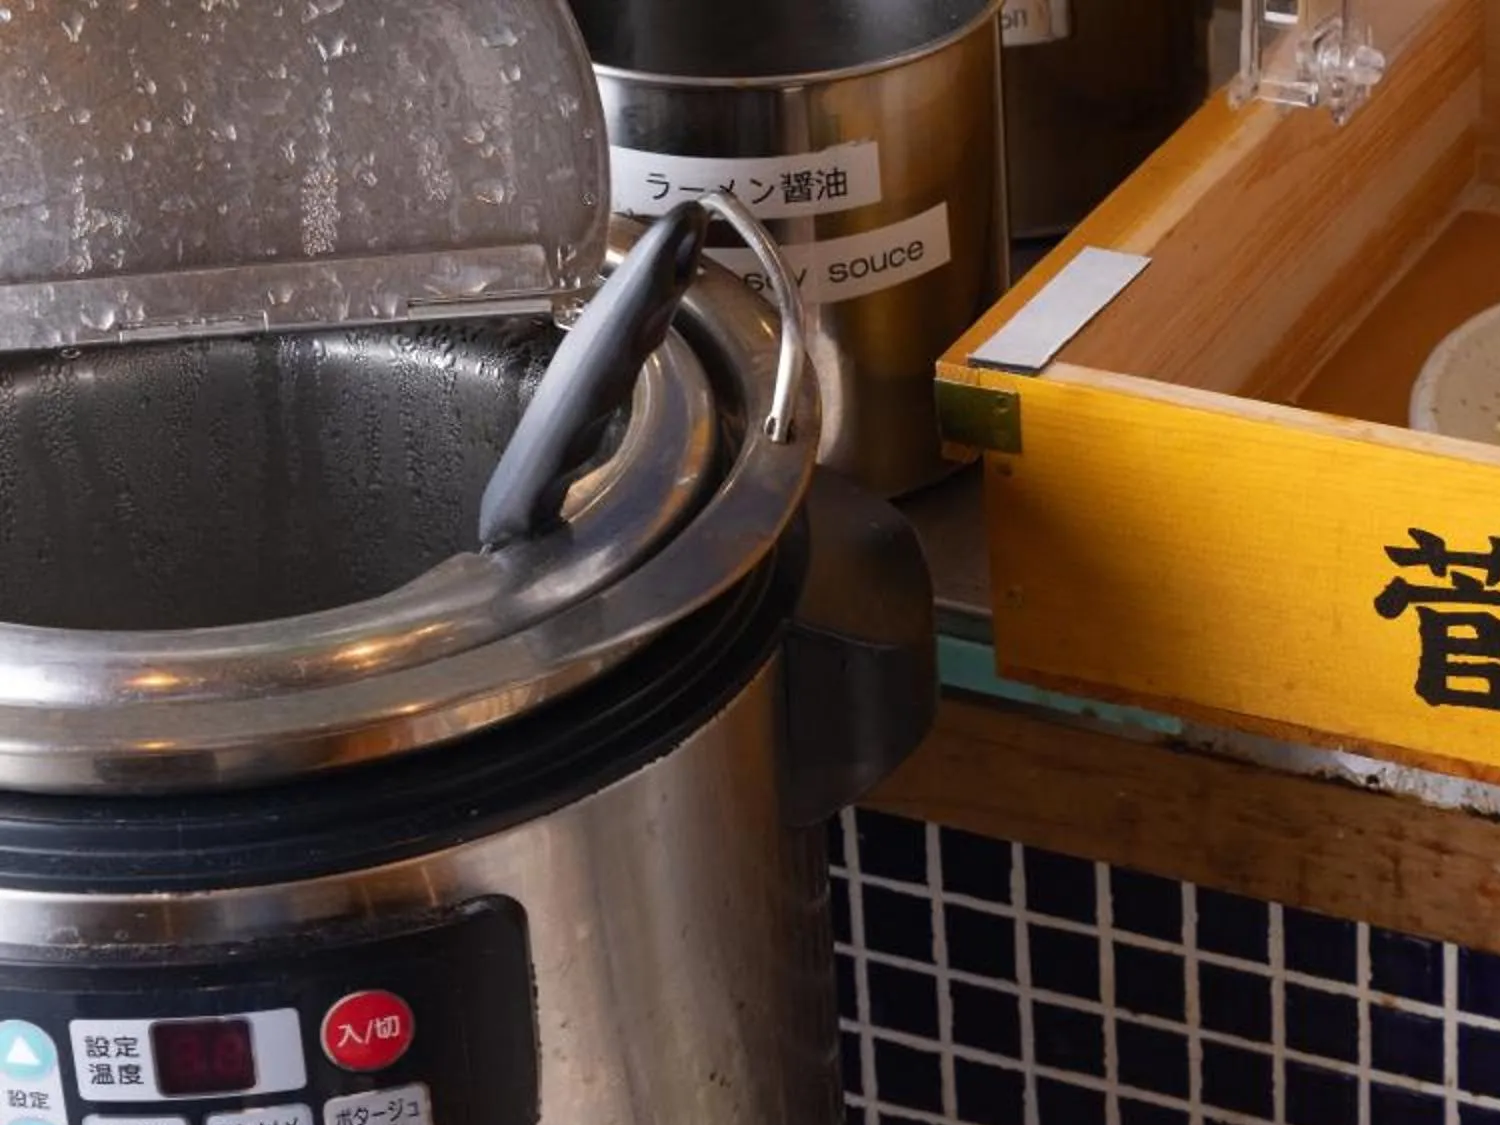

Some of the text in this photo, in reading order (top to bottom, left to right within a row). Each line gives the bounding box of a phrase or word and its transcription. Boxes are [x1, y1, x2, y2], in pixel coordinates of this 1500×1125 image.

[646, 166, 849, 204] ラーメン醤油
[828, 239, 925, 284] souce
[337, 1015, 400, 1048] 入/切
[84, 1035, 140, 1058] 設定
[88, 1063, 145, 1085] 温度
[7, 1089, 51, 1110] 設定
